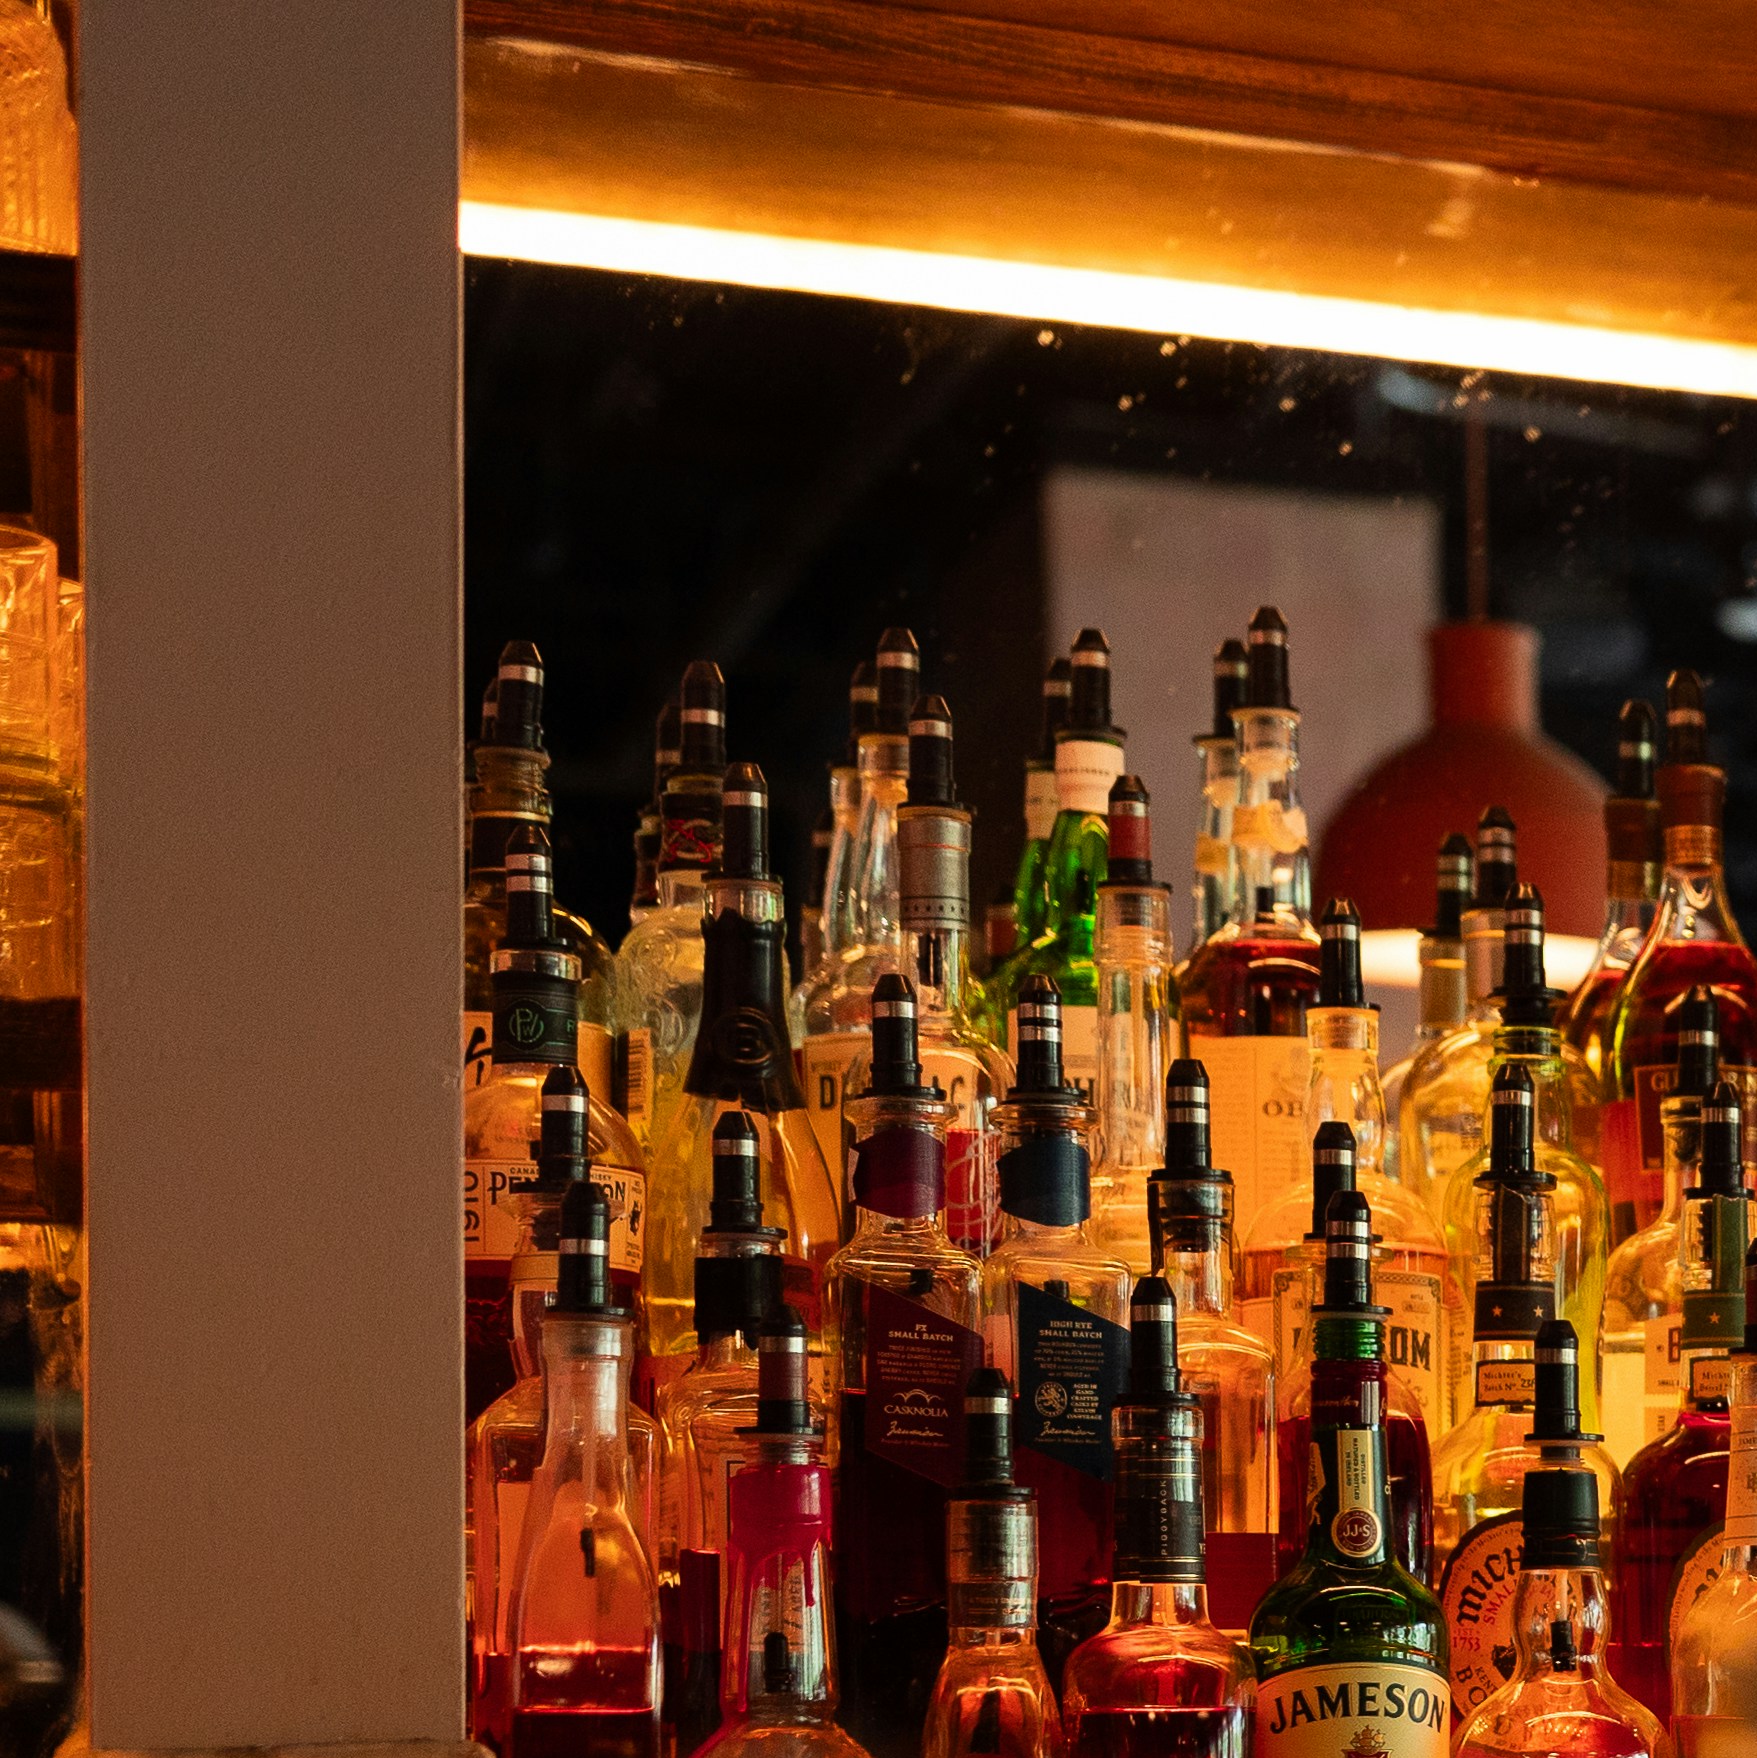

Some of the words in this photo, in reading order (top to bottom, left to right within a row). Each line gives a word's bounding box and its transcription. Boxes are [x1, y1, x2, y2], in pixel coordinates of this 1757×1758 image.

[1050, 1320, 1073, 1328] HIGH
[888, 1331, 920, 1339] SMALL
[922, 1333, 954, 1342] BATCH
[1072, 1331, 1102, 1339] BATCH
[884, 1404, 948, 1418] CASKNOLIA
[1452, 1636, 1481, 1652] 1753
[1269, 1681, 1445, 1734] JAMESON
